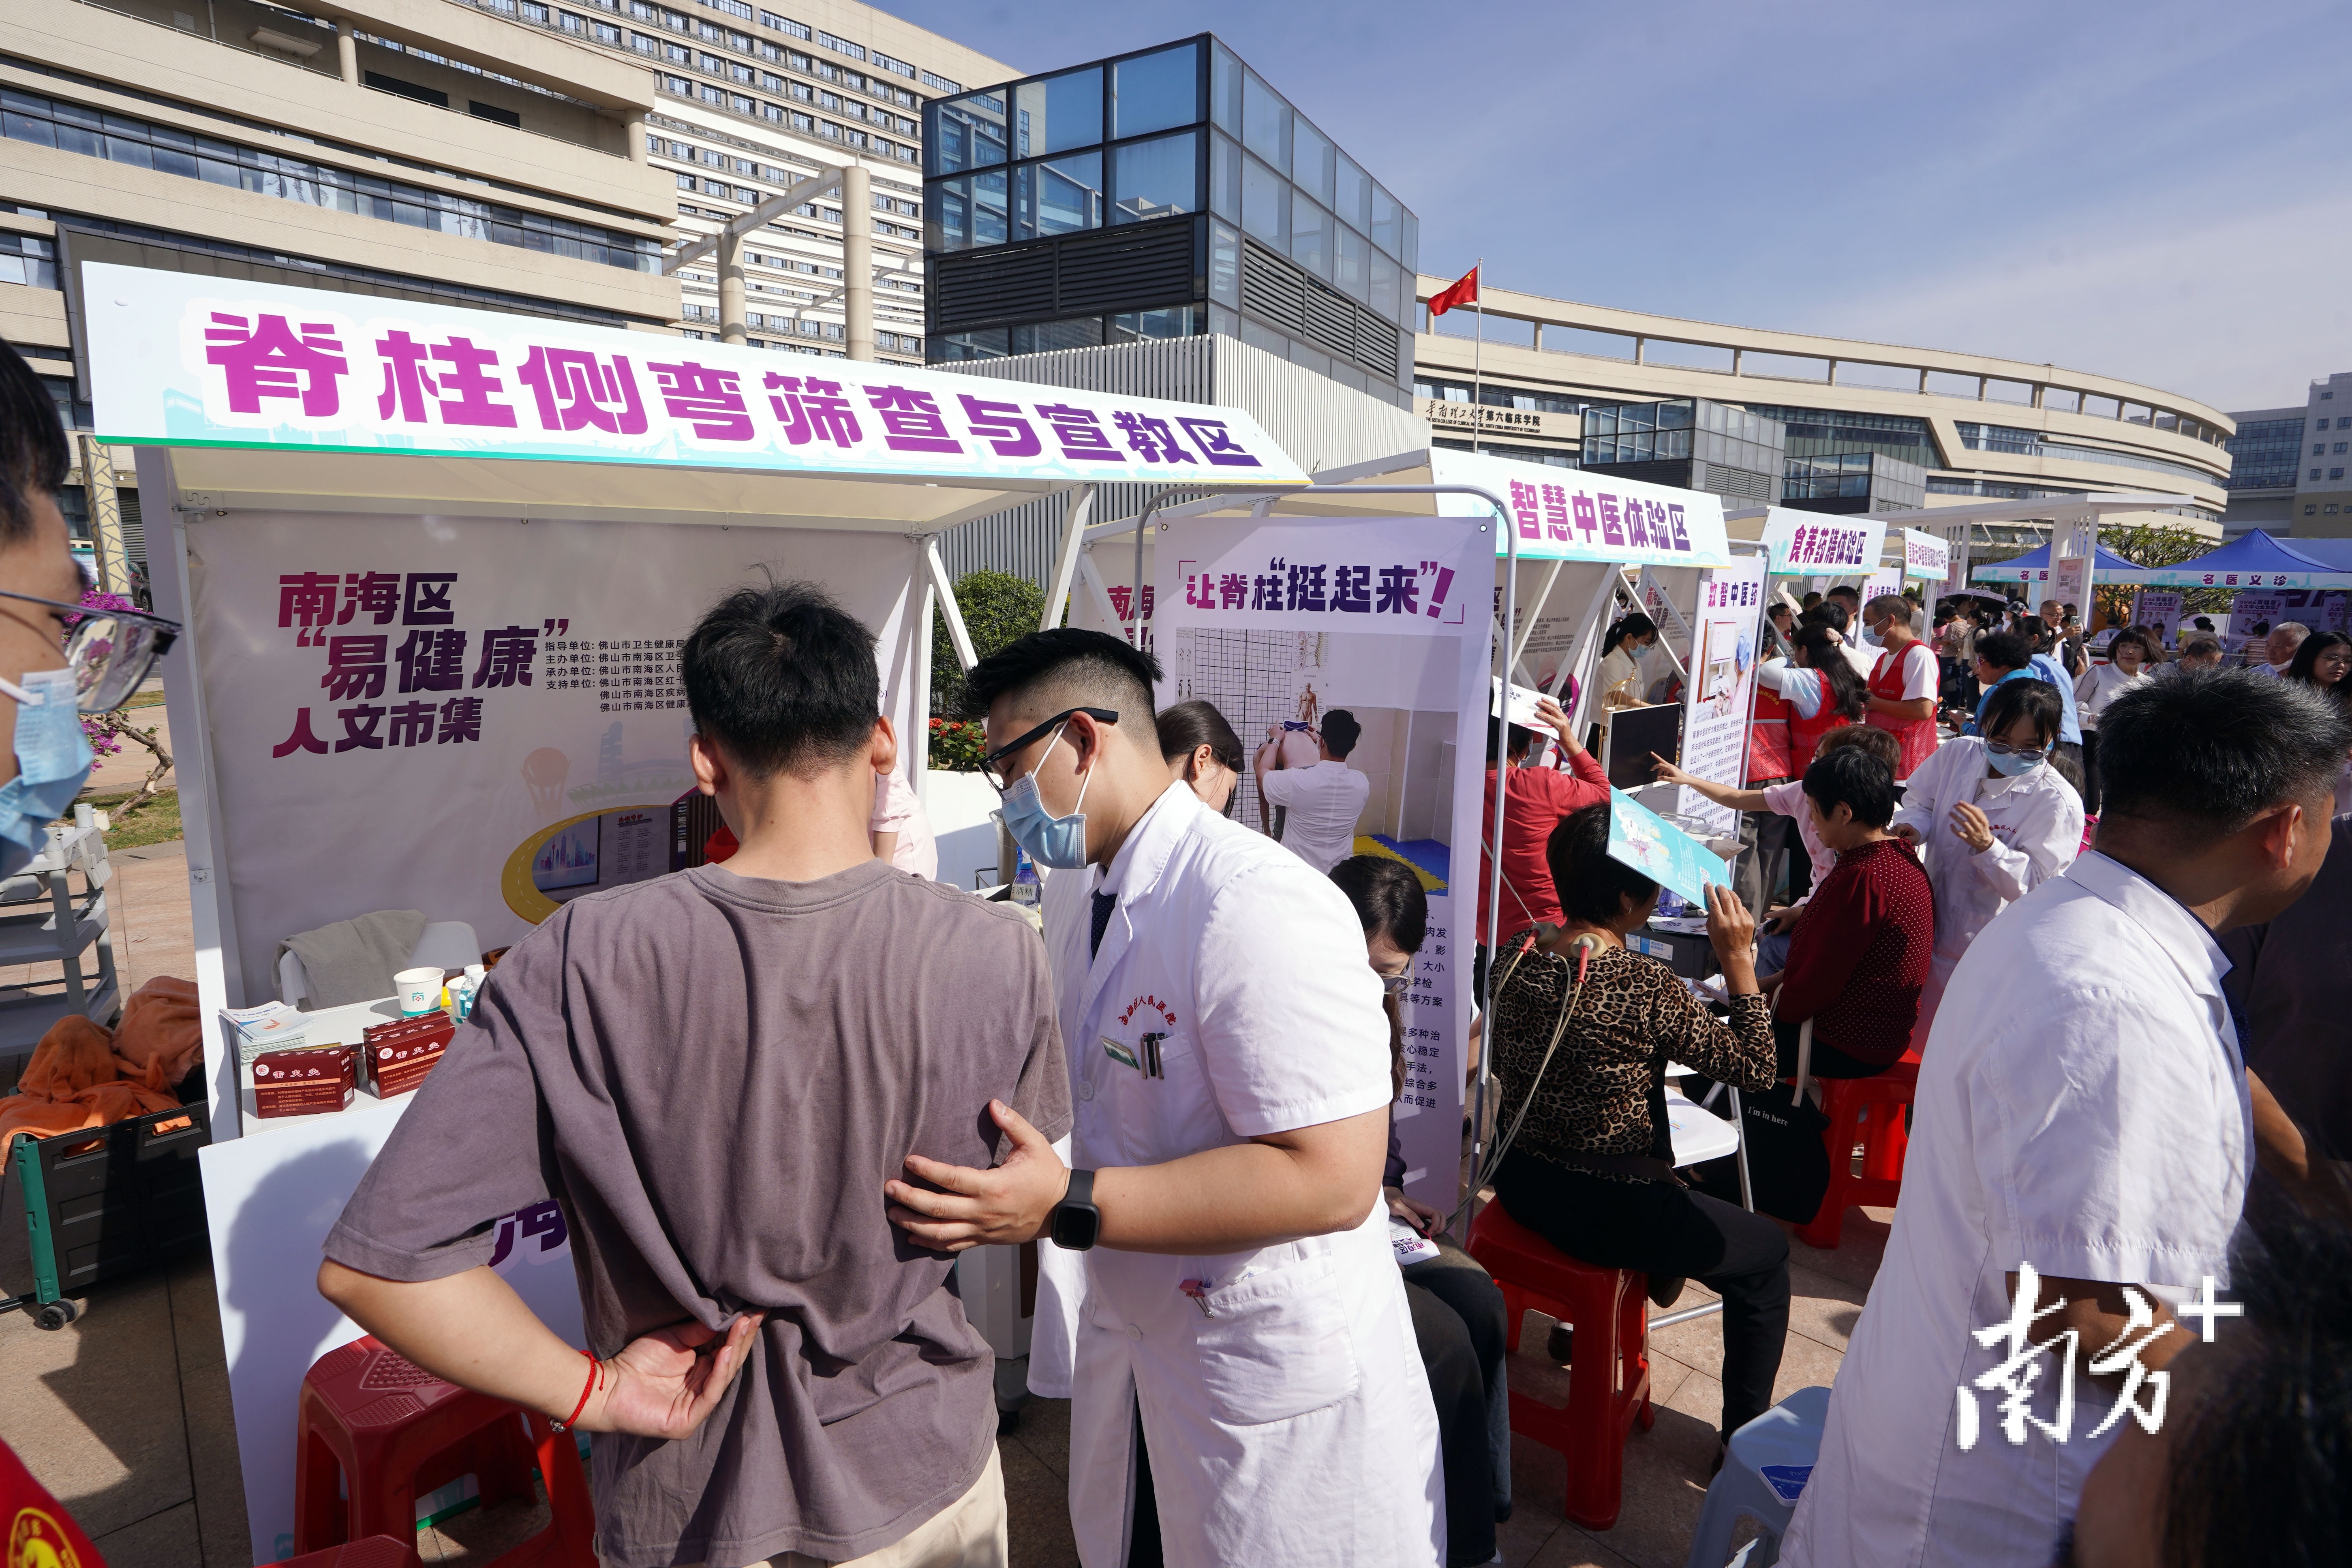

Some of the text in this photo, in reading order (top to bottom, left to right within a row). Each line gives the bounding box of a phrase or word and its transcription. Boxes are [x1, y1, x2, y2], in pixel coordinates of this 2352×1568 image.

[205, 311, 1263, 467] 脊柱侧弯筛查与宣教区
[1509, 478, 1691, 552] 智慧中医体验区
[1789, 524, 1867, 565] 食养药膳体验区
[2020, 570, 2048, 580] 名医
[2202, 573, 2288, 586] 名医义诊
[278, 571, 458, 628] 南海区
[1708, 581, 1759, 609] 数智中医药
[297, 619, 569, 701] “易健康”
[600, 700, 689, 712] 佛山市南海区健康
[273, 697, 483, 758] 人文市集
[1399, 993, 1442, 1007] 具等方案
[1404, 1078, 1437, 1091] 综合多
[1748, 1106, 1789, 1126] I'm in here
